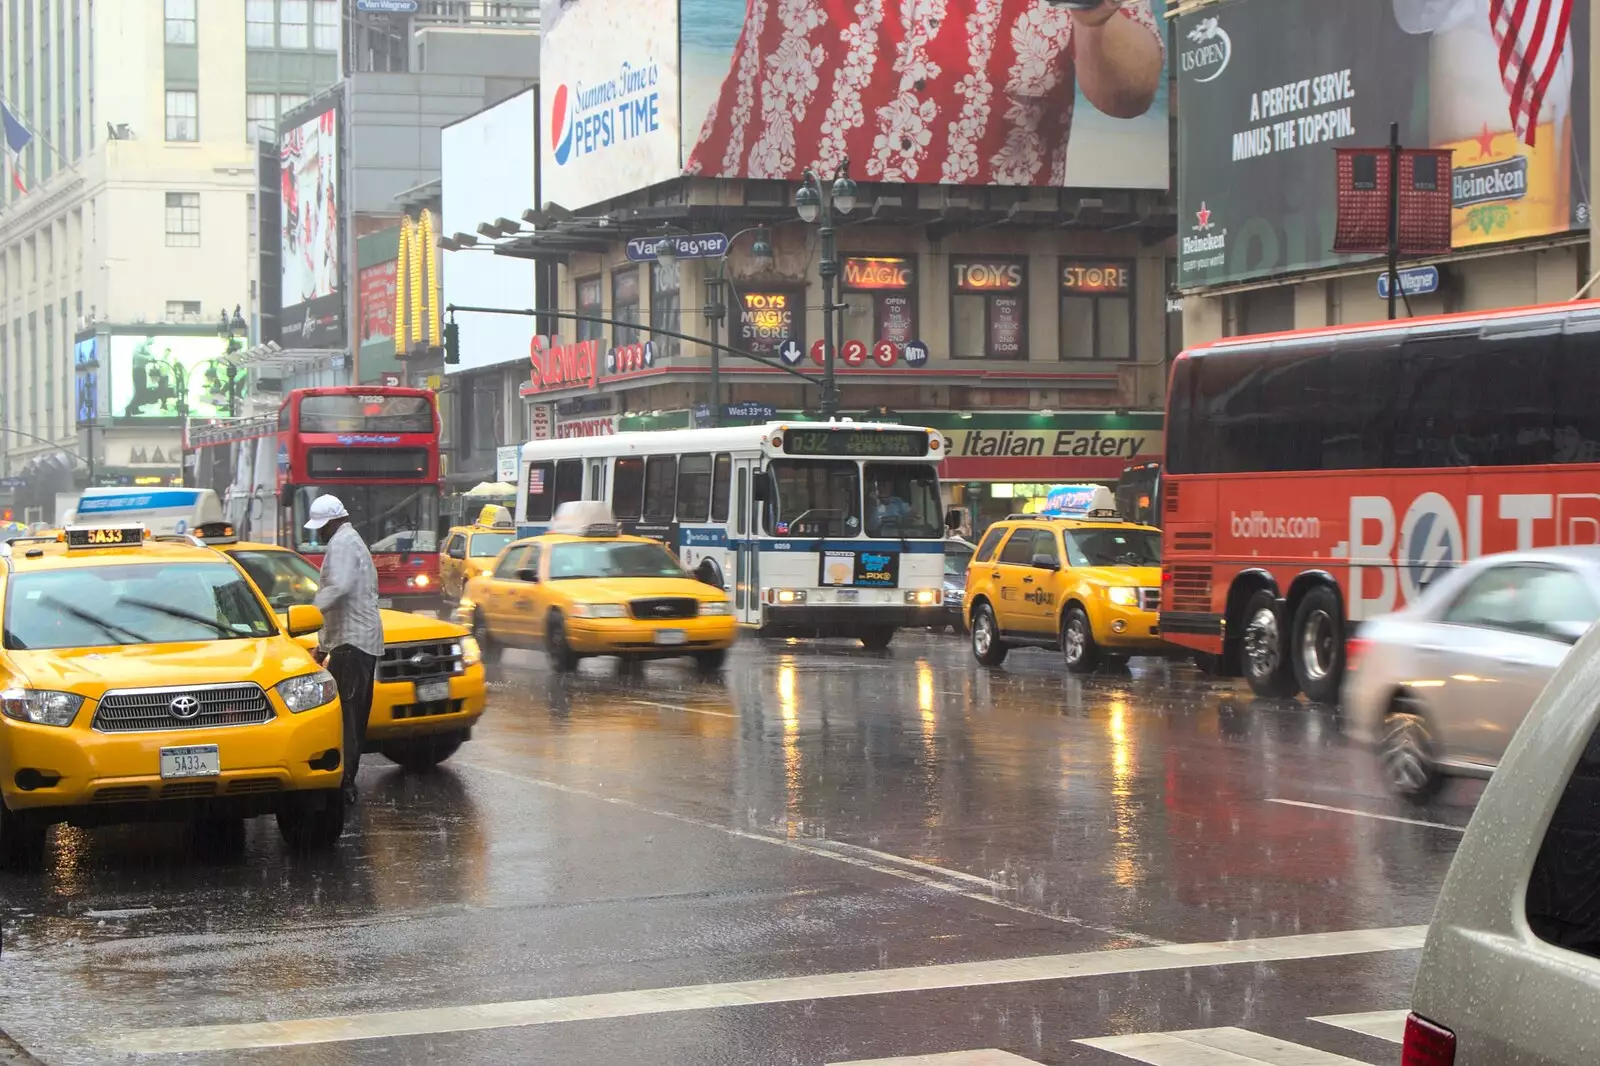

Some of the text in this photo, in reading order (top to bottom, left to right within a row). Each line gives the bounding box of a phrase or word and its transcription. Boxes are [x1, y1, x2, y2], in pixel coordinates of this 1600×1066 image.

[1181, 41, 1224, 71] US OPEN
[575, 56, 658, 114] Summer Time is
[1250, 69, 1355, 121] A PERFECT SERVE.
[576, 92, 659, 157] PEPSI TIME
[1232, 107, 1355, 161] MINUS THE TOPSPIN.
[1453, 165, 1525, 199] Heineken
[1183, 232, 1225, 254] Heineken
[842, 265, 912, 285] MAGIC
[953, 263, 1022, 287] TOYS
[1197, 258, 1209, 271] your
[1063, 267, 1128, 287] STORE
[744, 294, 785, 308] TOYS
[740, 310, 792, 323] MAGIC
[742, 325, 789, 338] STORE
[617, 346, 642, 366] 1 2 3
[818, 344, 825, 361] 1
[849, 344, 861, 361] 2
[880, 344, 892, 361] 3
[905, 347, 925, 361] MTA
[994, 343, 1018, 351] FLOOR
[530, 335, 599, 390] Subway
[728, 406, 772, 416] West 33rd St
[961, 430, 1045, 456] Italian
[1052, 430, 1145, 460] Eatery
[1231, 511, 1320, 538] boltbus.com
[87, 529, 123, 543] 5A33
